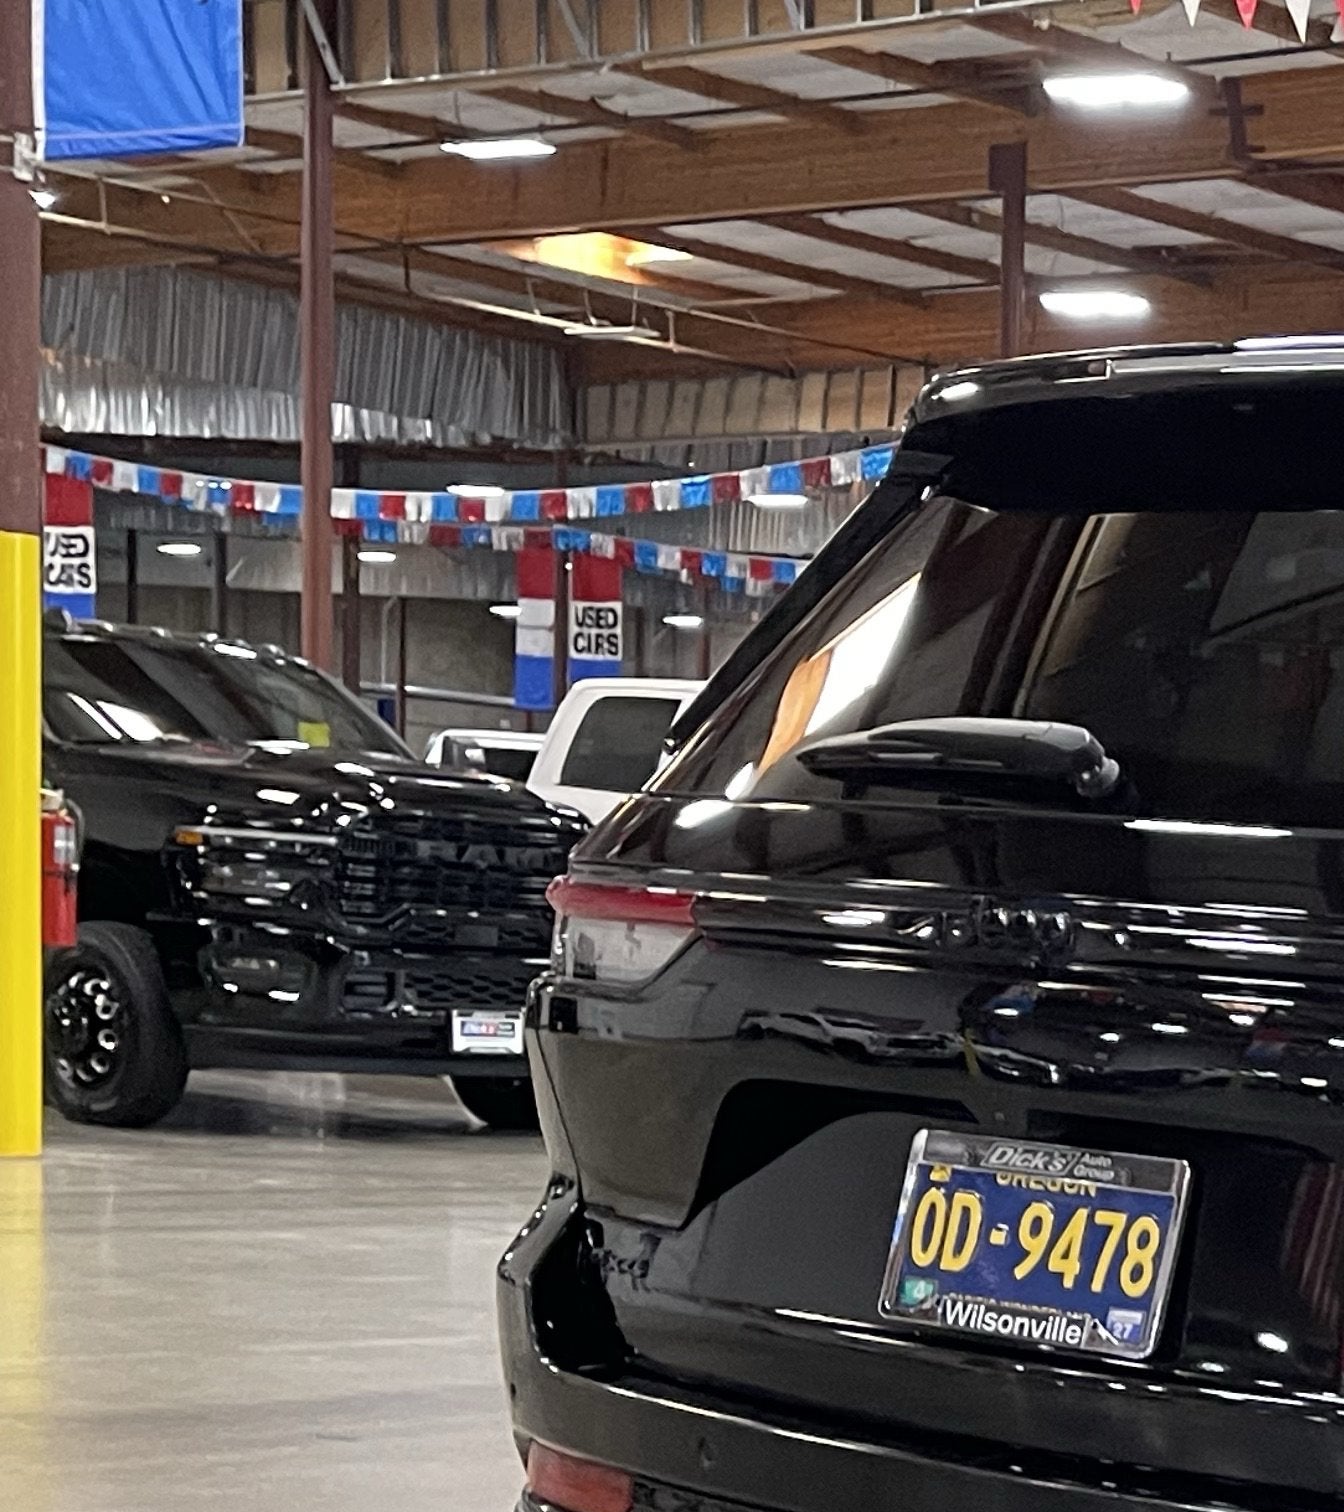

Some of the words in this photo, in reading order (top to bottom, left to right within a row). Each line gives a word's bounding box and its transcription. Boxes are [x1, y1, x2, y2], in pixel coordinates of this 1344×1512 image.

[574, 606, 618, 630] USED
[988, 1146, 1067, 1172] Dick's
[1073, 1164, 1115, 1181] Group
[945, 1300, 1082, 1345] Wilsonville
[1112, 1321, 1133, 1339] 27
